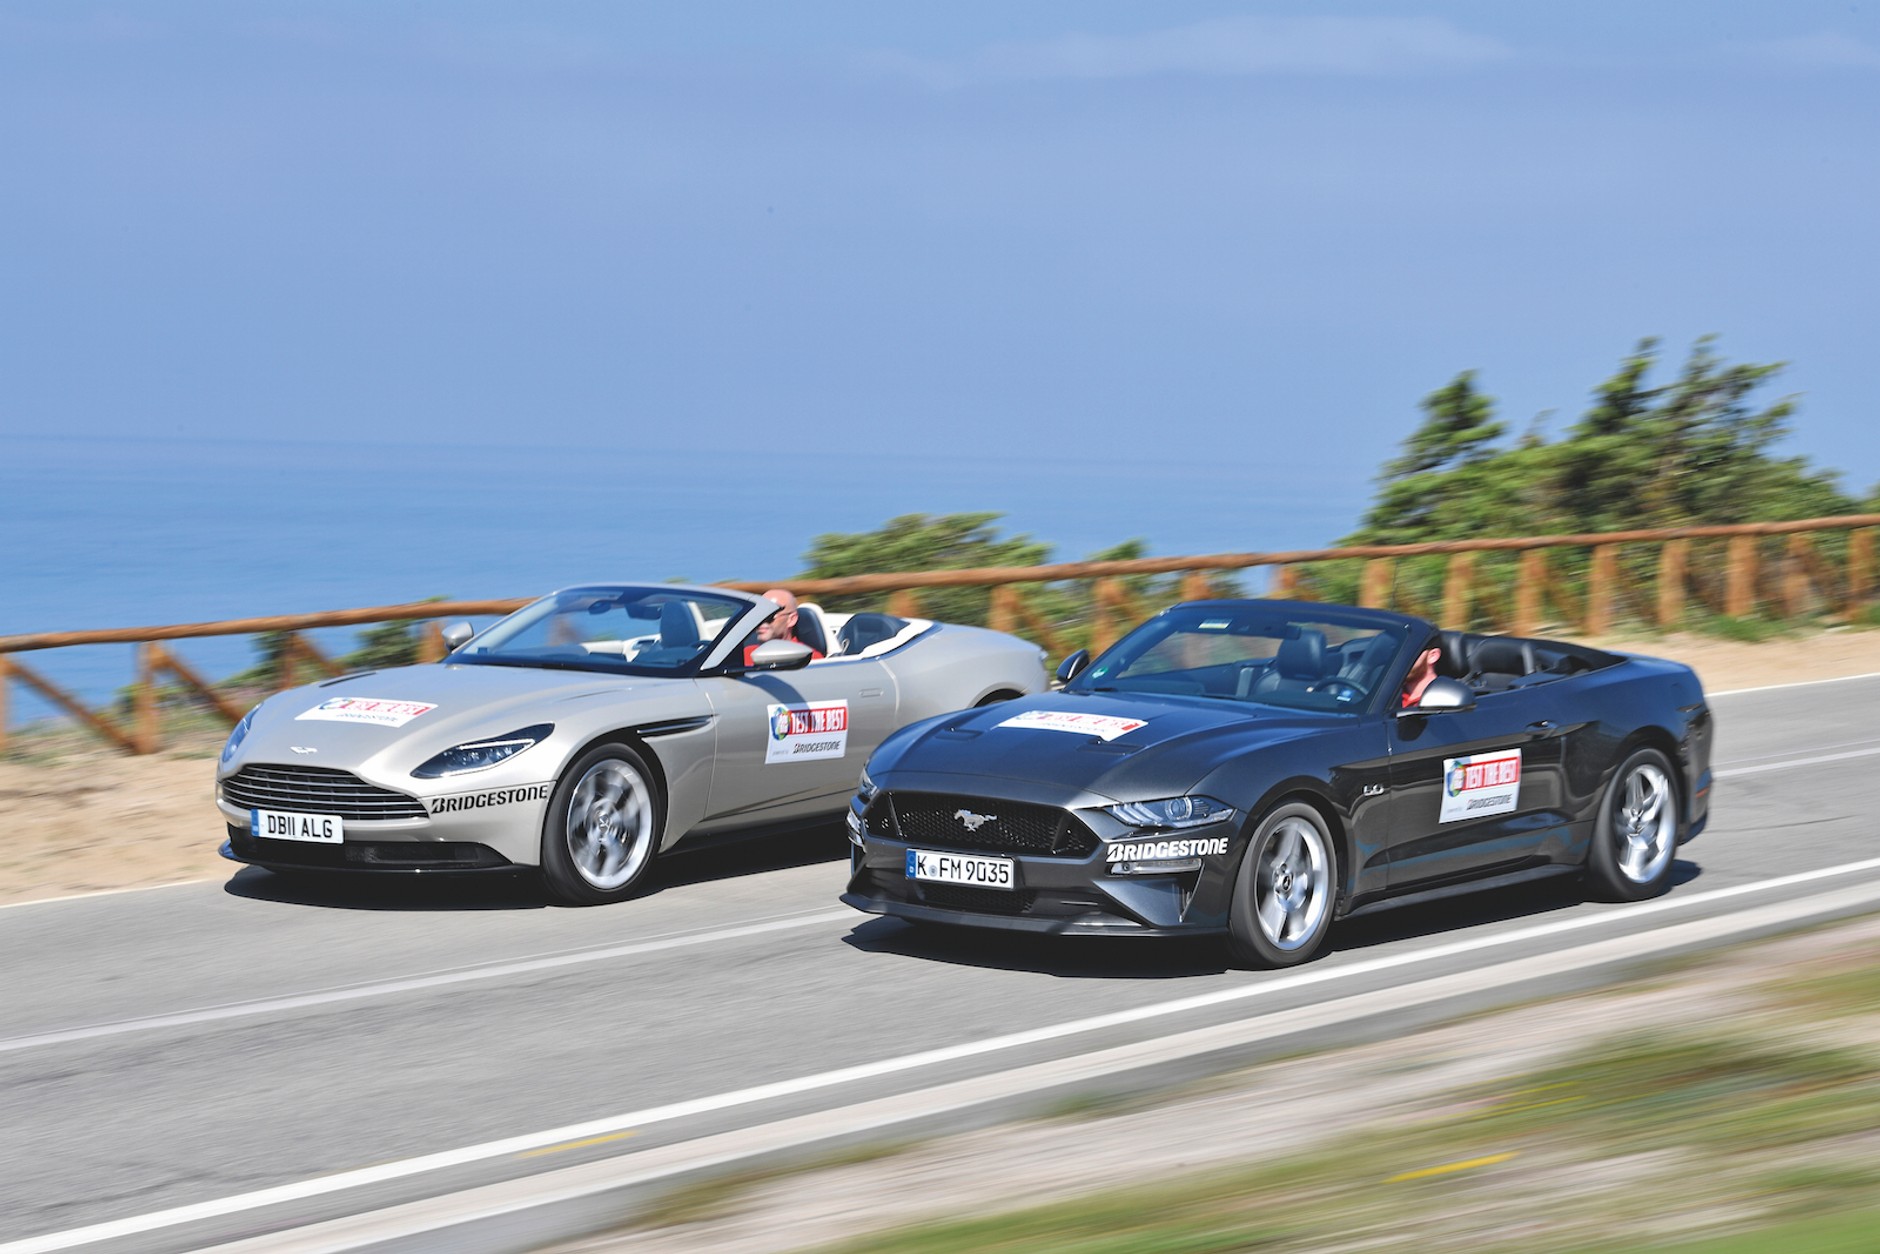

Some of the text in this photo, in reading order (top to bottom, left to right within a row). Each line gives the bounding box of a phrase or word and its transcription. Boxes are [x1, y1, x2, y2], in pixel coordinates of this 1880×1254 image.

[791, 711, 809, 734] TEST
[810, 711, 825, 732] THE
[826, 709, 844, 731] BEST
[793, 741, 840, 754] BRIDGESTONE
[431, 785, 548, 815] BRIDGESTONE
[301, 819, 333, 838] ALG
[1106, 837, 1229, 863] BRIDGESTONE
[917, 855, 1010, 884] K FM 9035
